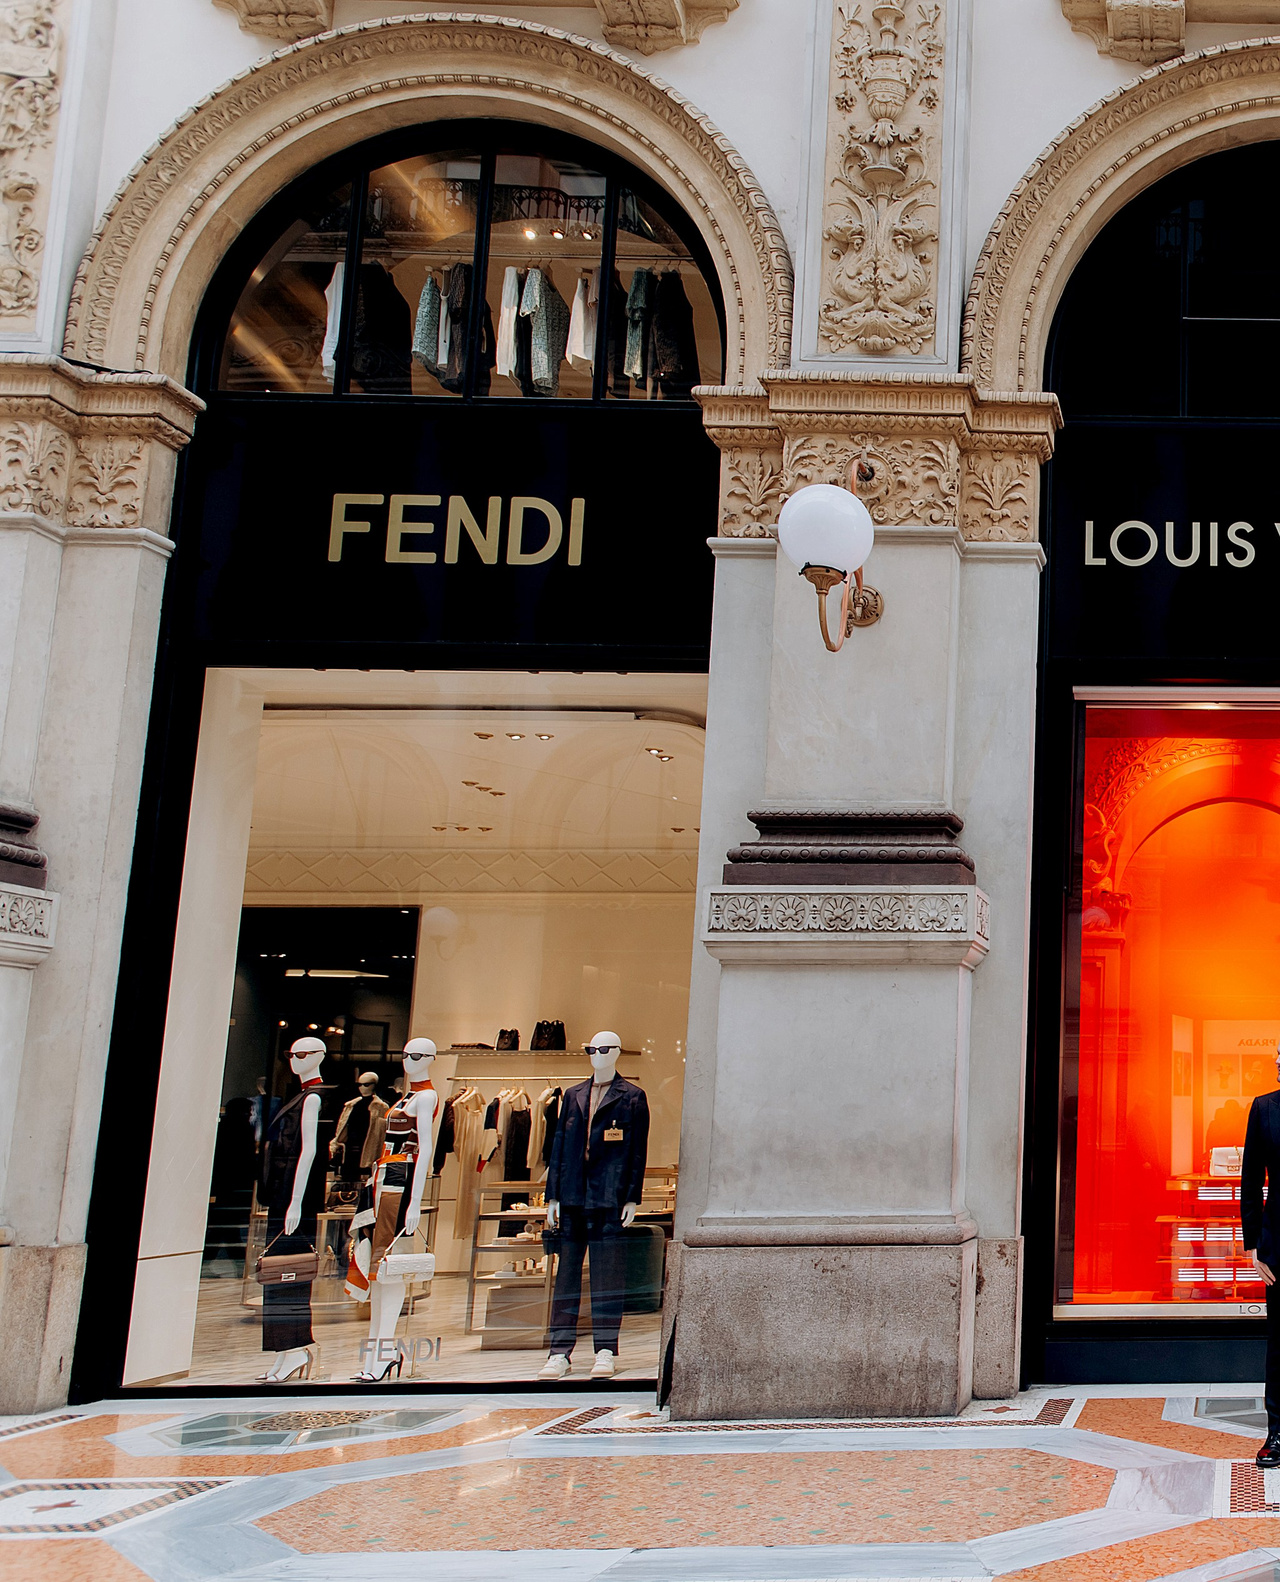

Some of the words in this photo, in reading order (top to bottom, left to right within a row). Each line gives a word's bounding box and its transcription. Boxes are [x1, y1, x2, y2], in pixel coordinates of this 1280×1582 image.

[327, 493, 586, 567] FENDI
[1084, 520, 1256, 568] LOUIS
[358, 1336, 442, 1363] FENDI
